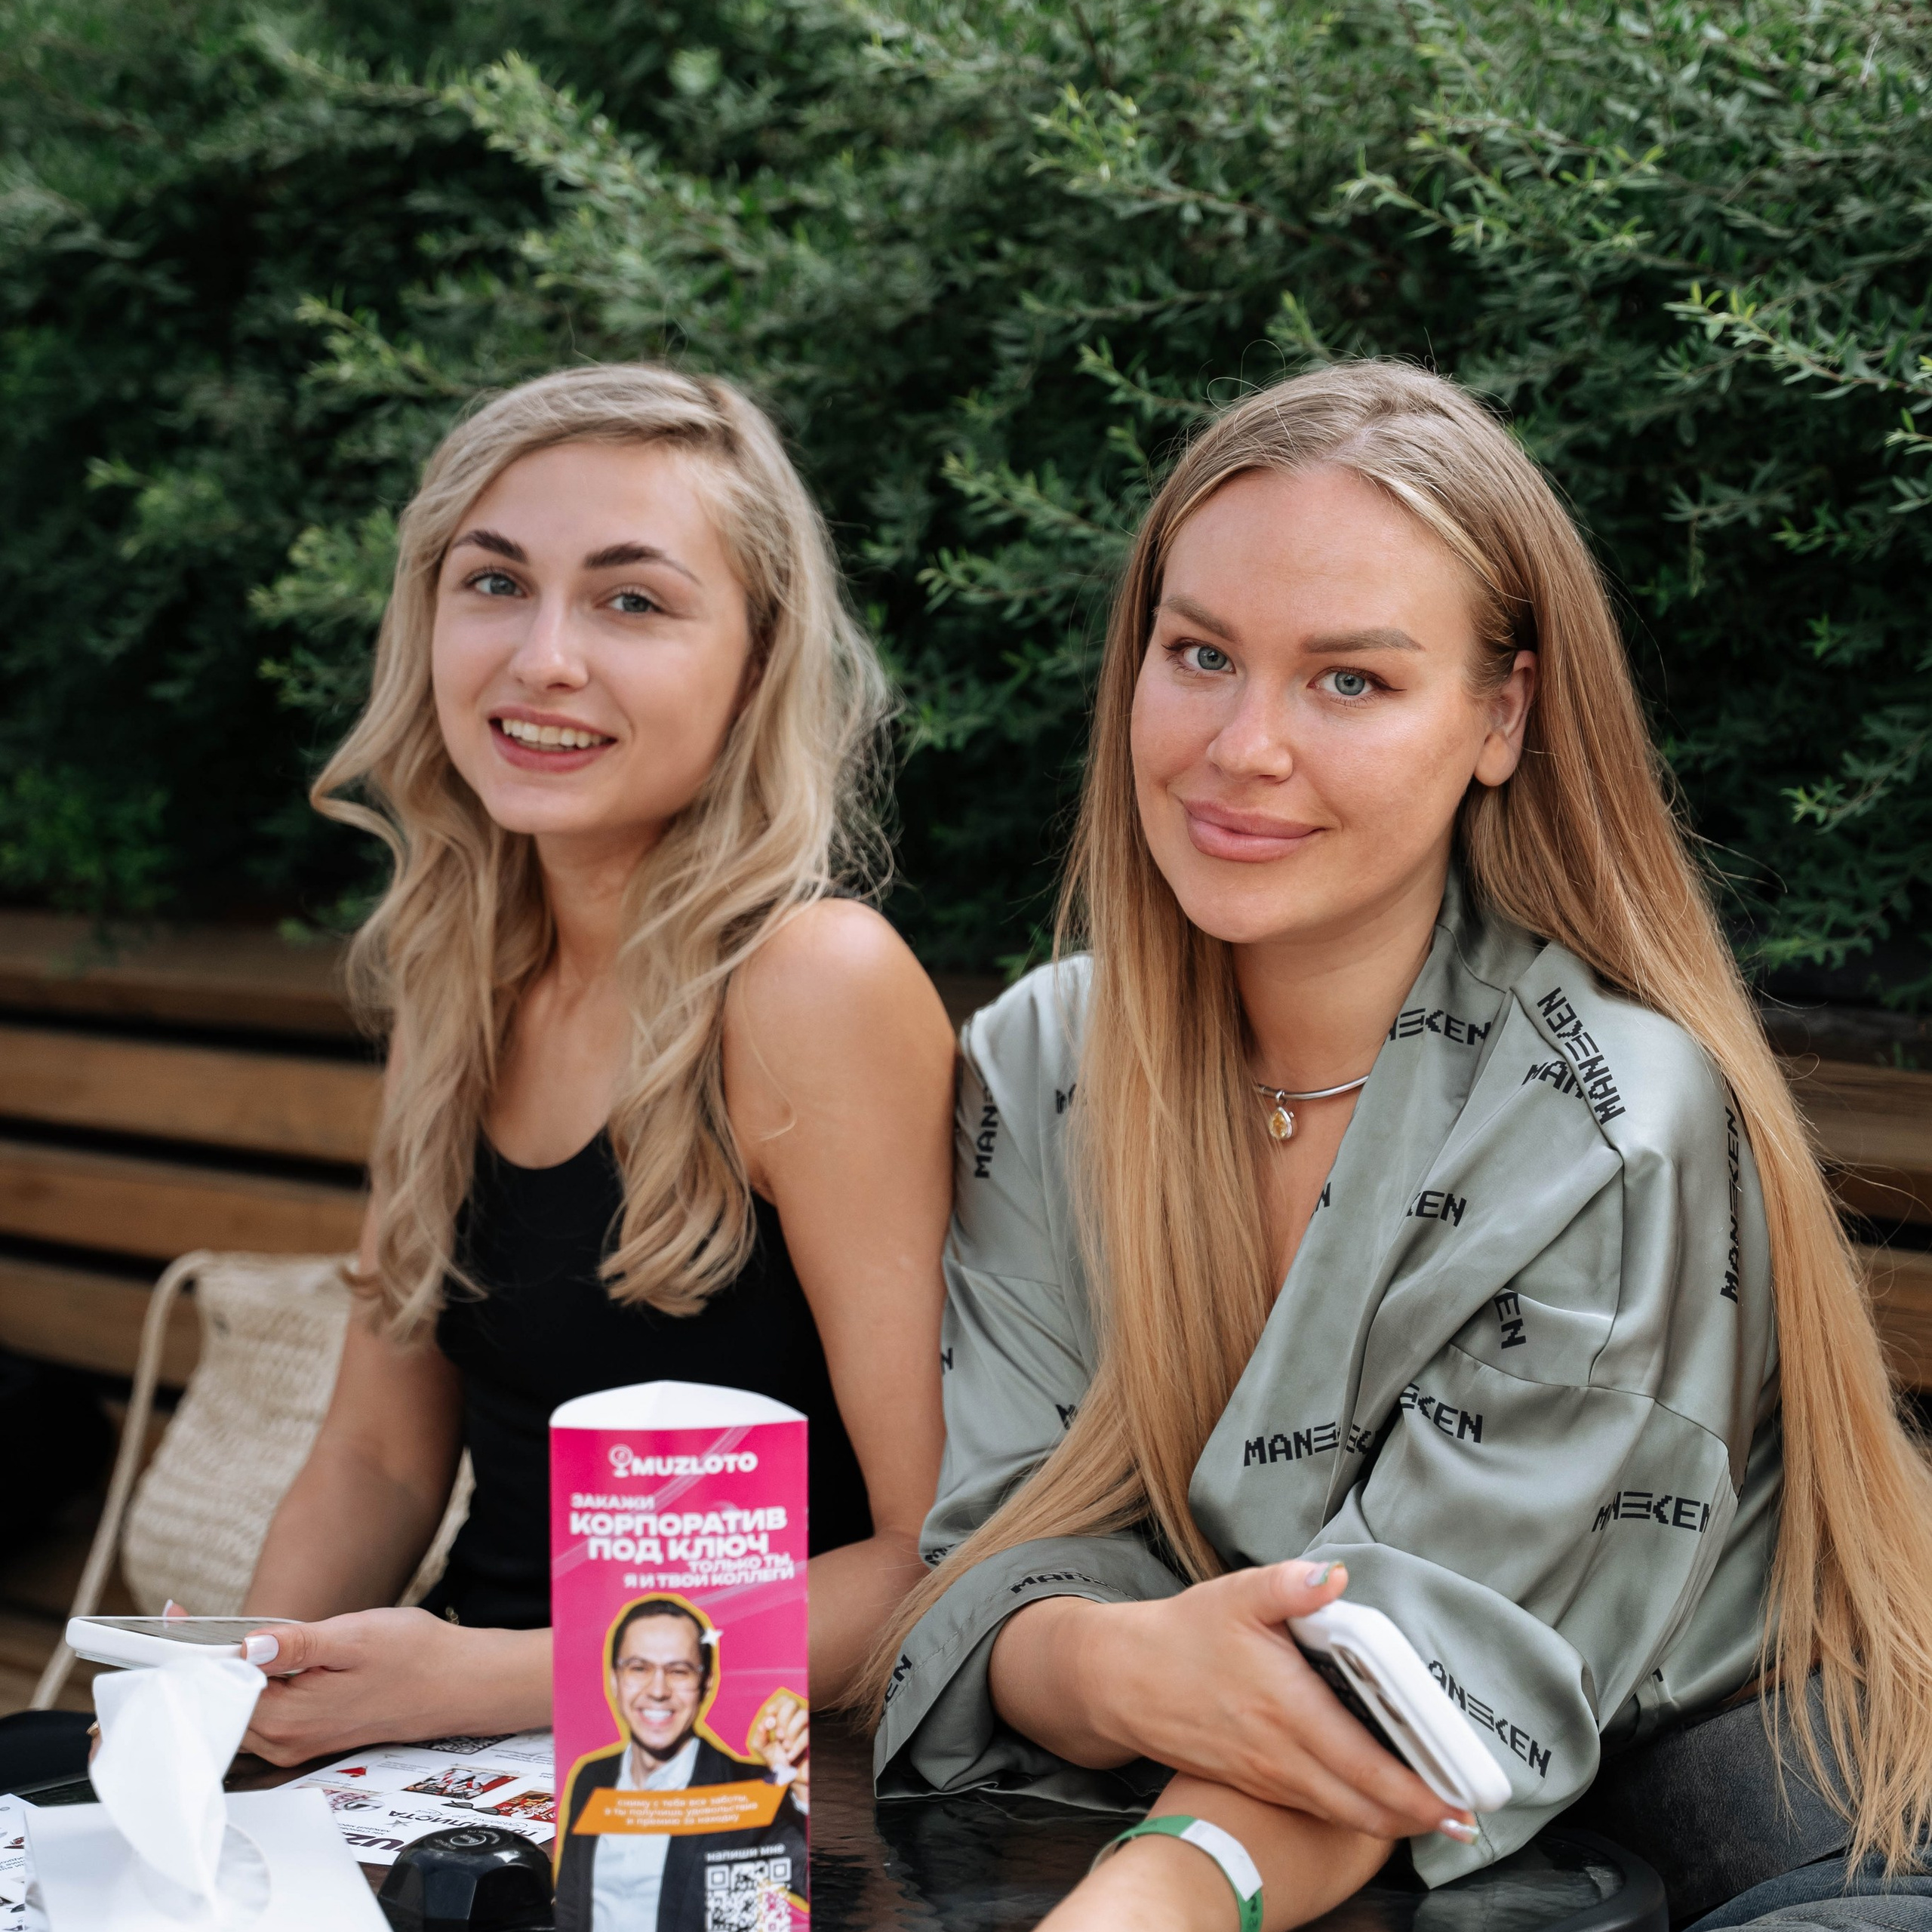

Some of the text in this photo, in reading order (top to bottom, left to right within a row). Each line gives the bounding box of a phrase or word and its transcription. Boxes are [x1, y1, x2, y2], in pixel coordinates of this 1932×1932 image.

[1537, 986, 1626, 1125] MANEKEN
[632, 1451, 758, 1476] MUZLOTO
[571, 1493, 655, 1509] ЗАКАЖИ
[570, 1506, 787, 1537] КОРПОРАТИВ
[589, 1533, 769, 1564] ПОД КЛЮЧ
[688, 1555, 762, 1574] ТОЛЬКО
[624, 1573, 637, 1588] Я
[639, 1573, 654, 1588] И
[705, 1847, 757, 1862] напиши
